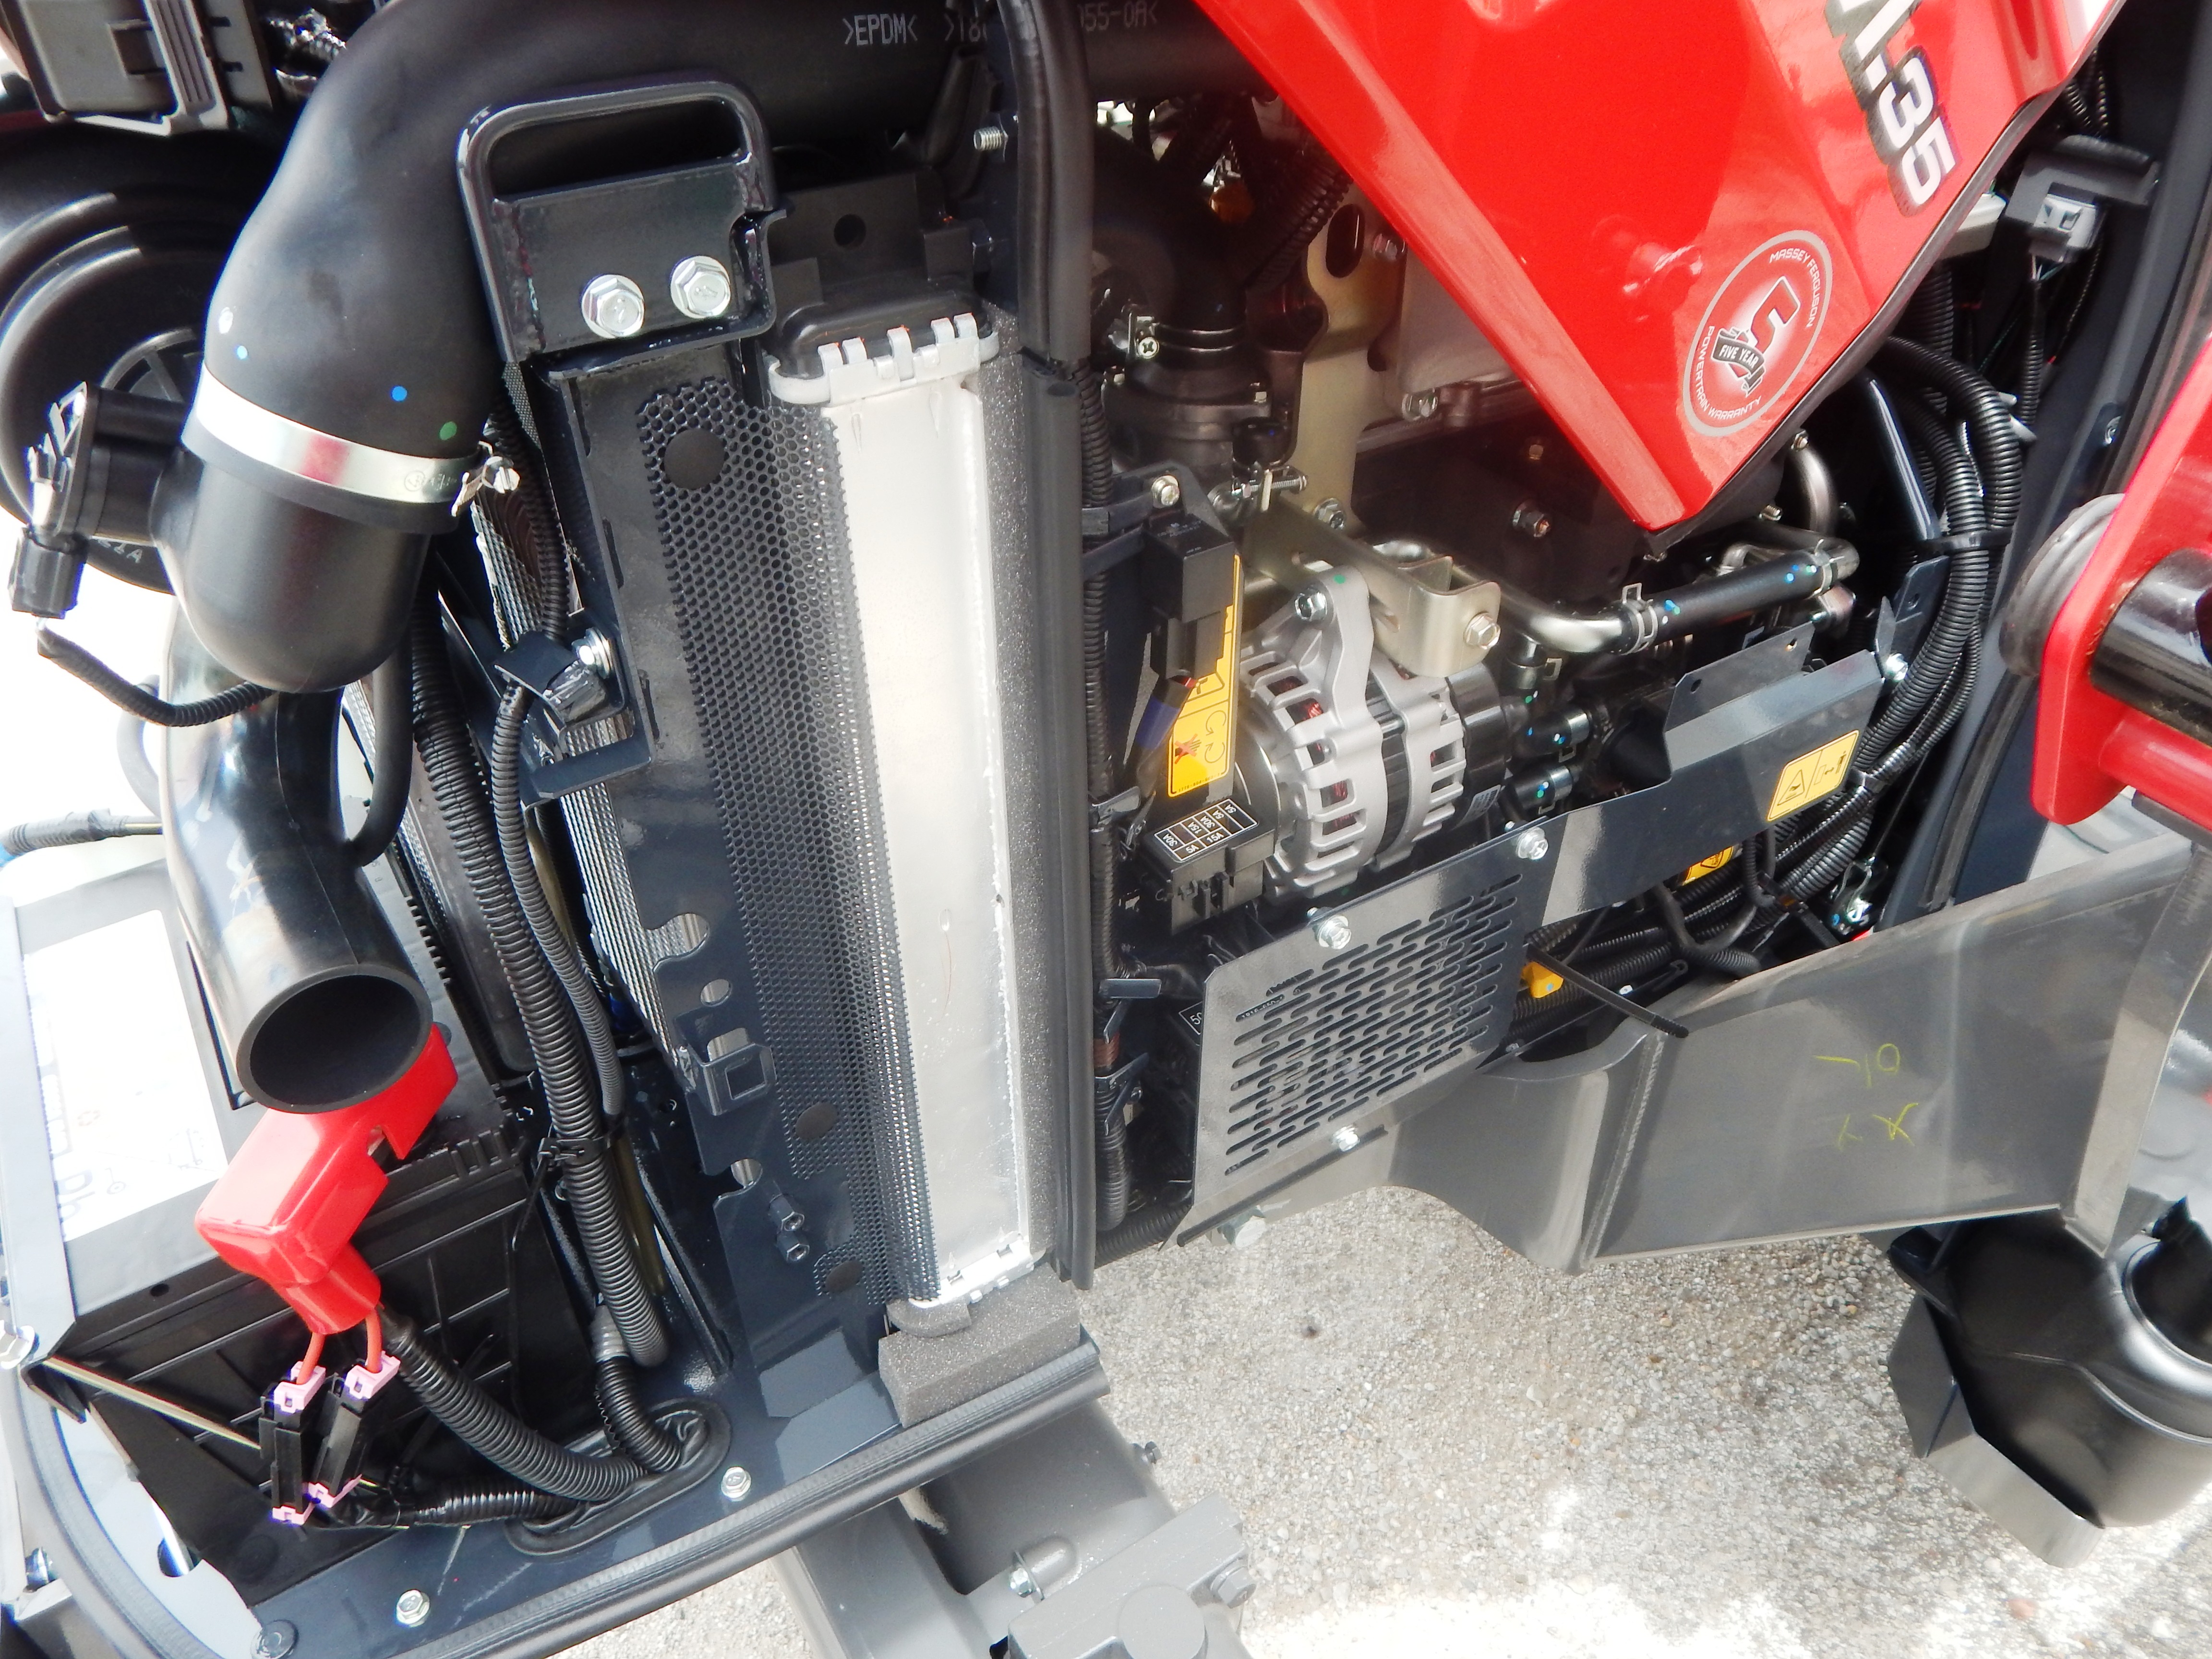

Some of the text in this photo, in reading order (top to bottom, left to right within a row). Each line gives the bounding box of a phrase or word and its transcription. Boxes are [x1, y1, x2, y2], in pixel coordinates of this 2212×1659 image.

[1769, 248, 1821, 328] MASSEY FERGUSON
[1719, 345, 1759, 368] FIVE YEAR
[1696, 326, 1761, 420] POWERTRAIN WARRANTY
[1212, 810, 1225, 819] 5A
[1225, 805, 1237, 813] 5A
[1188, 821, 1202, 834] 15A
[1200, 816, 1215, 828] 30A
[1163, 833, 1178, 847] 30A
[1206, 832, 1224, 843] 15A
[1186, 844, 1199, 854] 5A
